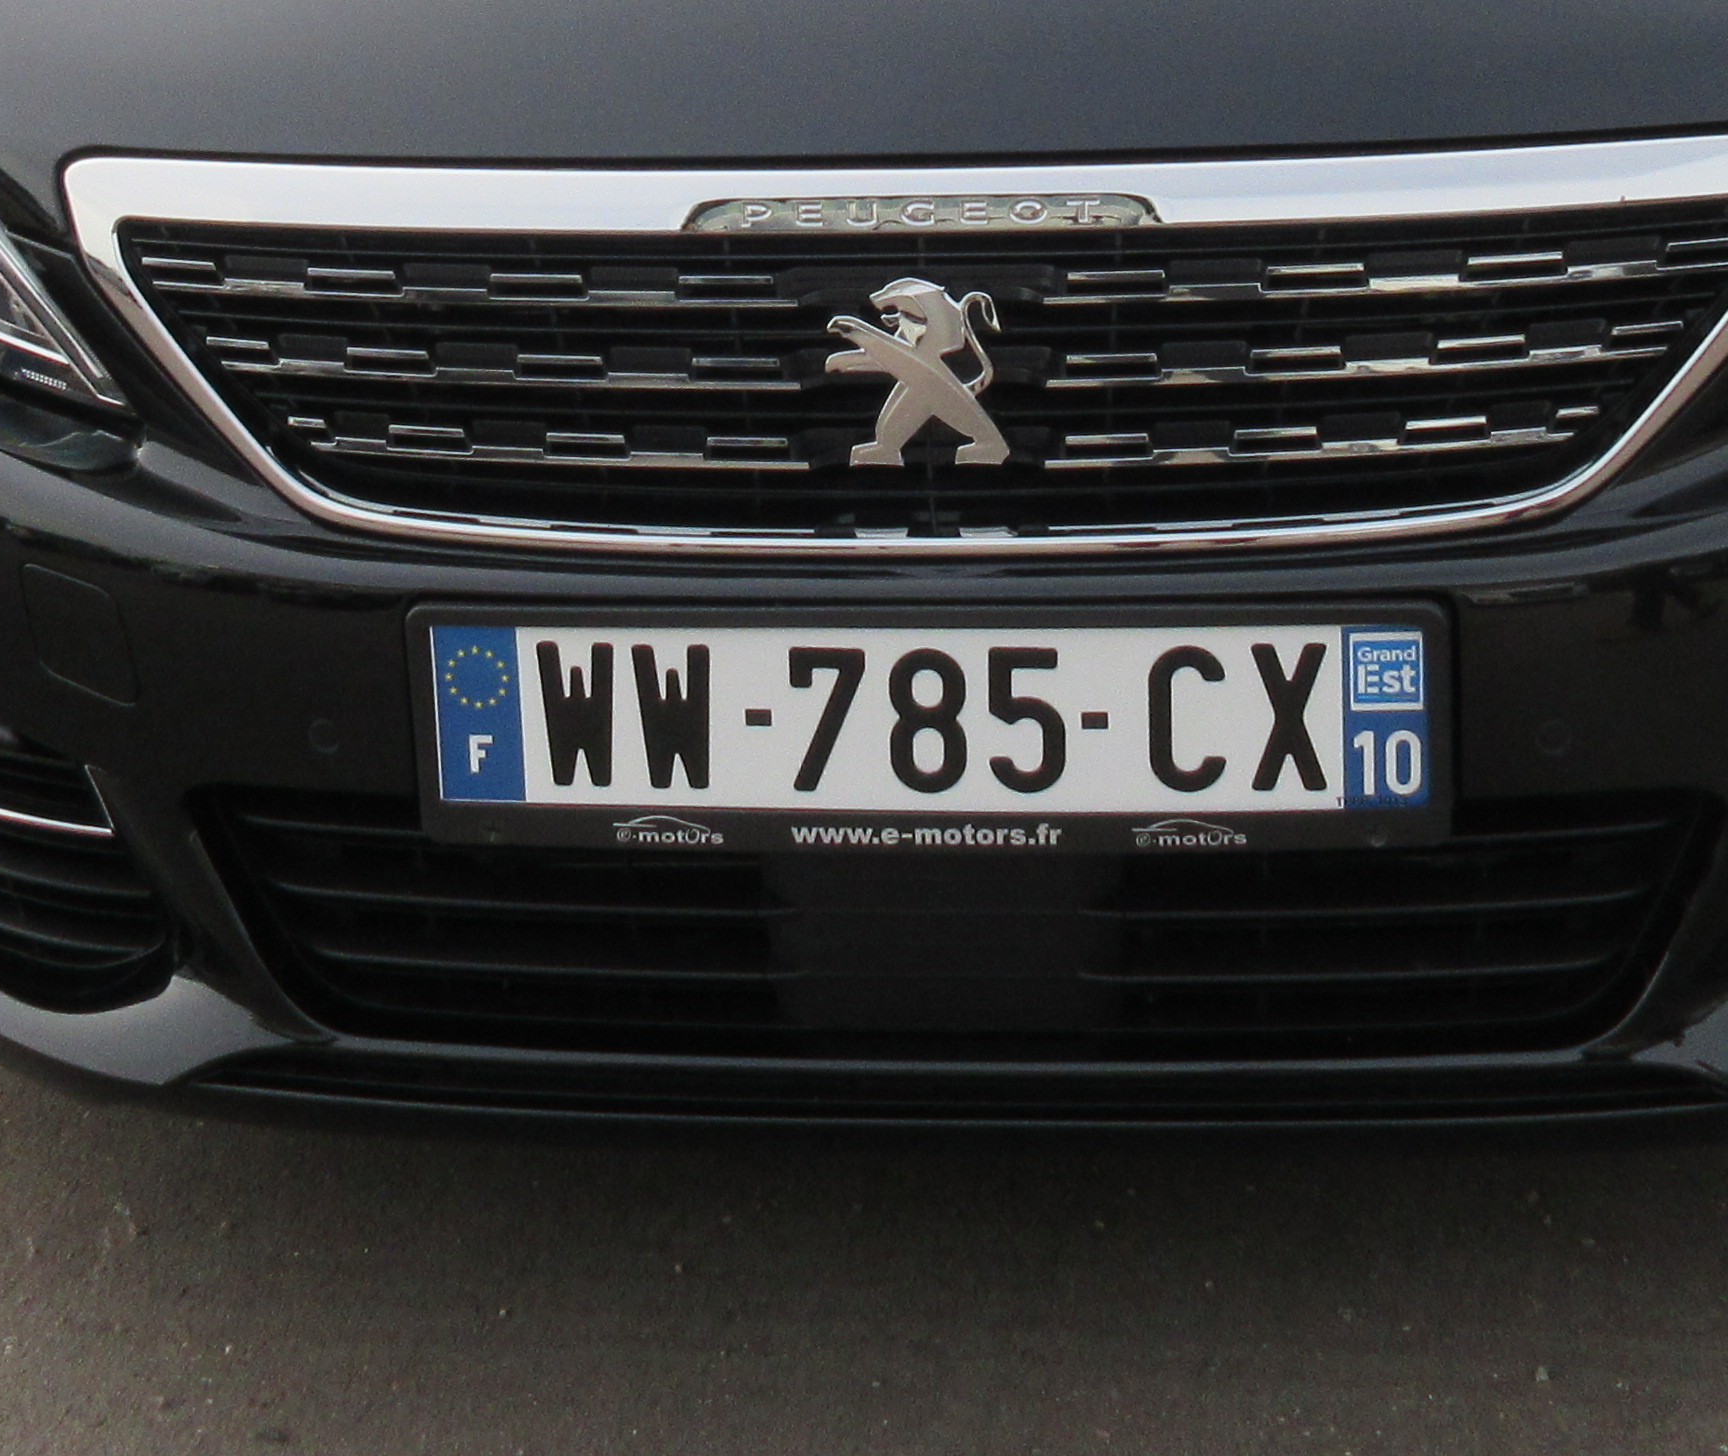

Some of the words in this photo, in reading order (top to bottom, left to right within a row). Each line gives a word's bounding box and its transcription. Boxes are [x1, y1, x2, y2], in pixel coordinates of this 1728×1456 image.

[740, 195, 1101, 228] PEUGEOT
[1357, 646, 1417, 662] Grand
[1357, 664, 1417, 694] Est
[469, 734, 493, 773] F
[1353, 729, 1422, 796] 10
[791, 823, 1062, 845] www.e-motors.fr
